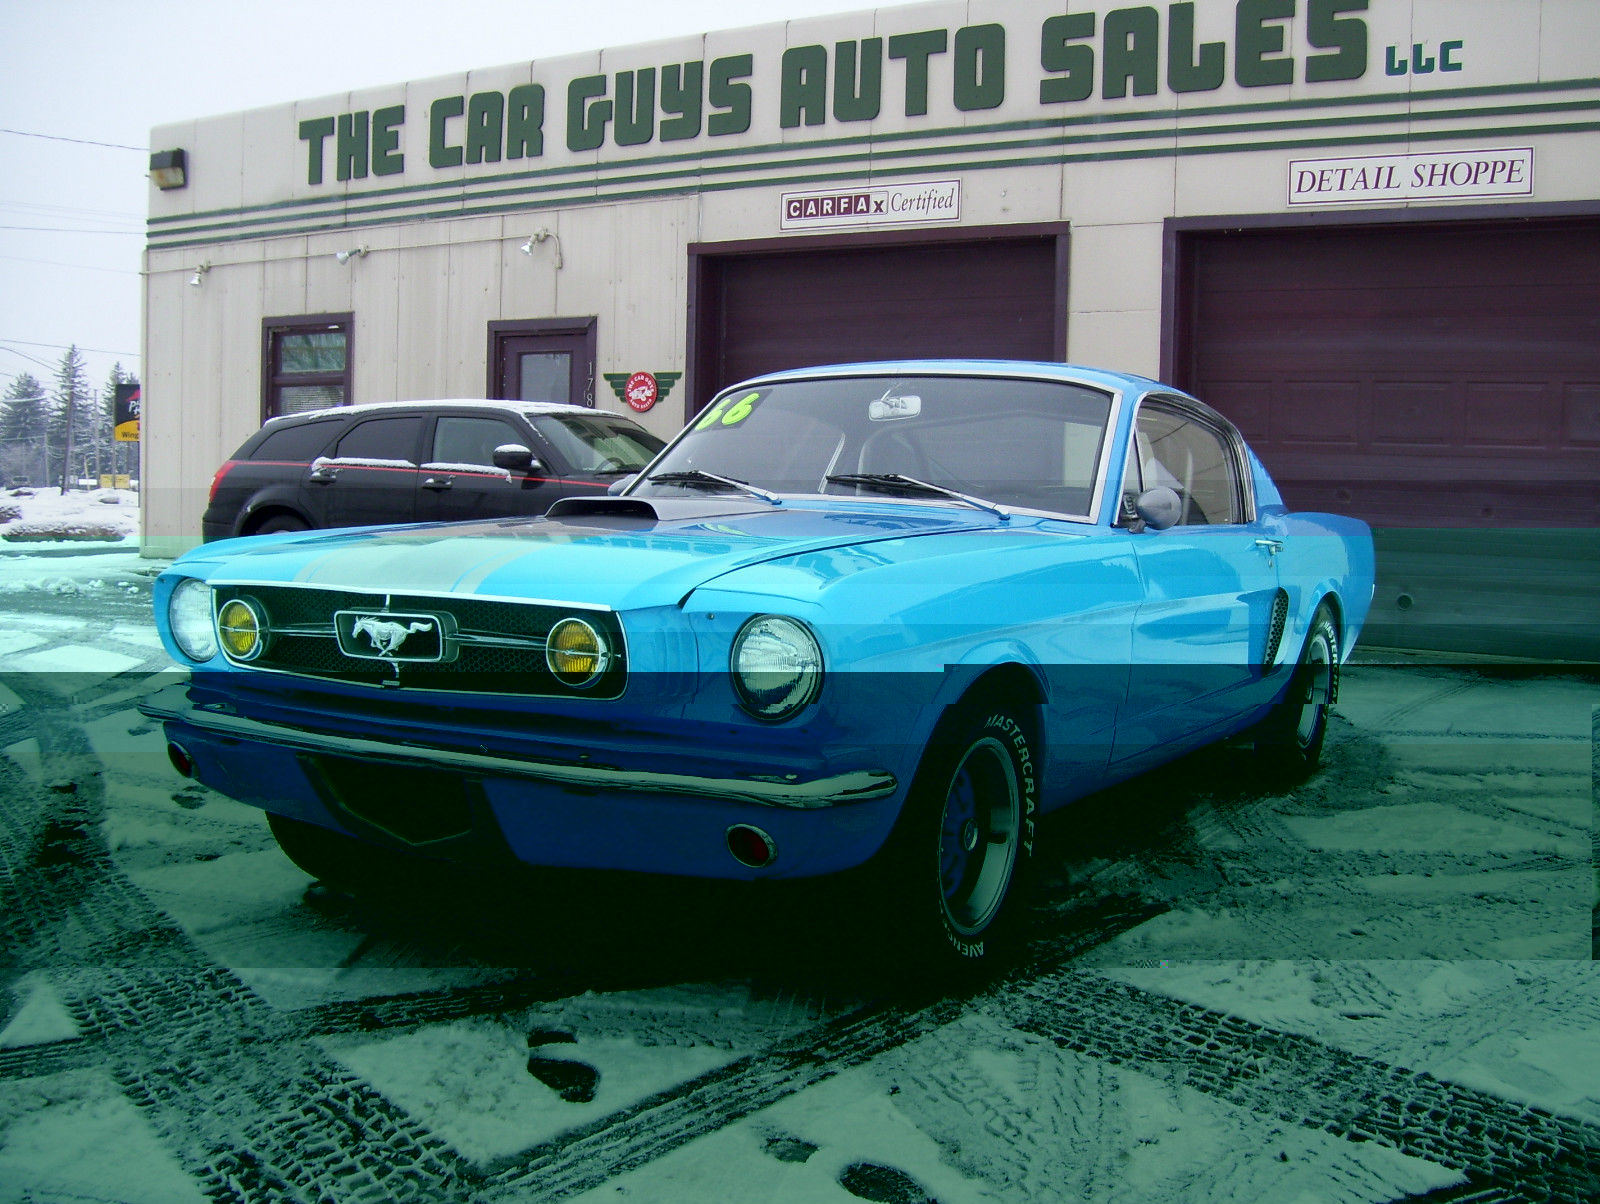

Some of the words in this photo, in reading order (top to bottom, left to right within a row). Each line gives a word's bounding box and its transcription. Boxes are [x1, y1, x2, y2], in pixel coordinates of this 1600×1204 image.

[299, 105, 405, 186] THE
[429, 83, 545, 169] CAR
[566, 53, 754, 153] GUYS
[779, 22, 1006, 129] AUTO
[1039, 0, 1369, 105] SALES
[1385, 40, 1463, 77] LLC
[787, 195, 885, 219] CARFAX
[891, 187, 955, 216] Certified
[1294, 165, 1402, 195] DETAIL
[1410, 158, 1525, 189] SHOPPE
[984, 714, 1035, 858] MASTERCRAFT
